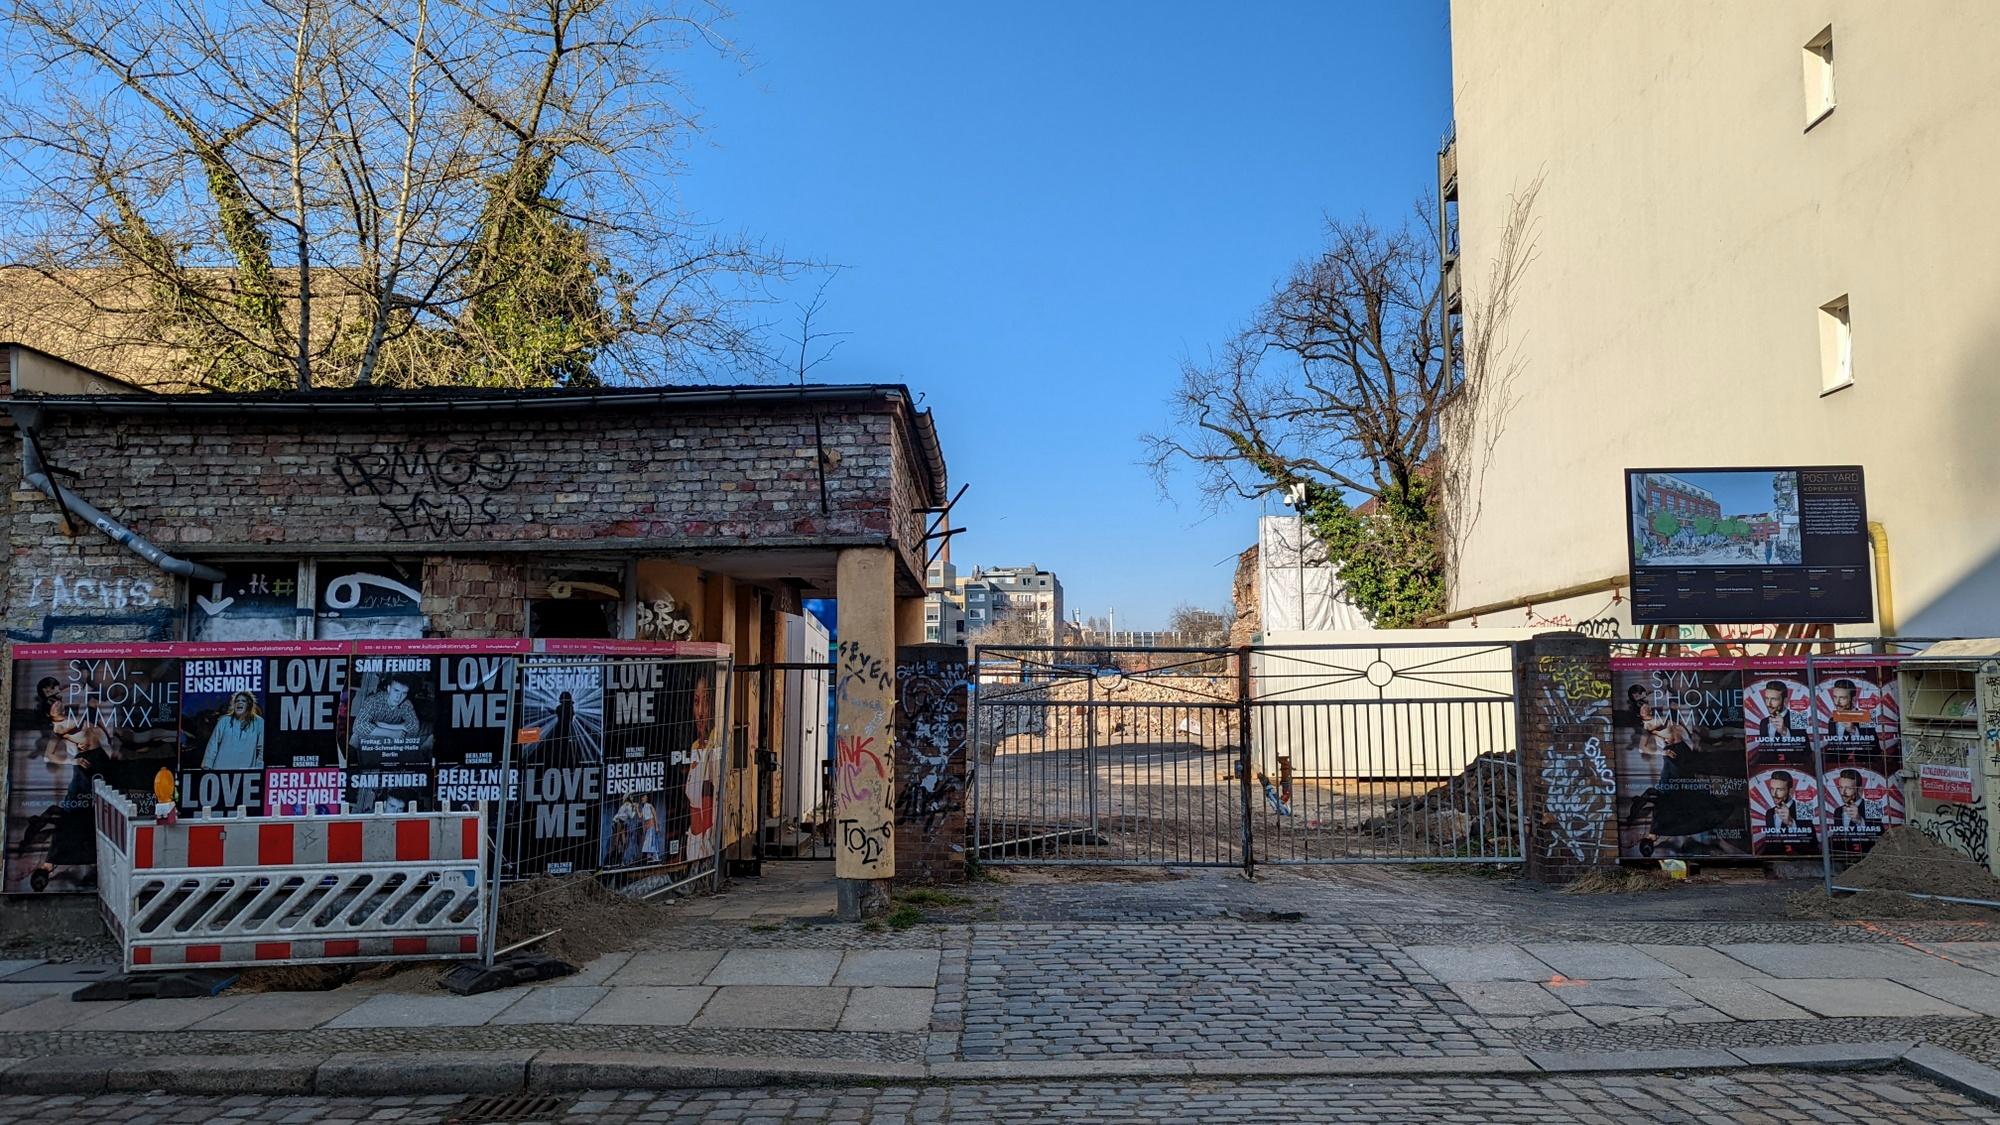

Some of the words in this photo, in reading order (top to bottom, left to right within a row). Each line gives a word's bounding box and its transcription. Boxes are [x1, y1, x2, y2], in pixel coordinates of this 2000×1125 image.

[1802, 473, 1828, 483] POST
[1832, 472, 1859, 481] YARD
[68, 660, 144, 681] SYM-
[185, 659, 263, 677] BERLINER
[355, 659, 383, 673] SAM
[385, 658, 432, 672] FENDER
[440, 656, 521, 691] LOVE
[606, 658, 665, 690] LOVE
[185, 676, 262, 693] ENSEMBLE
[268, 658, 348, 693] LOVE
[528, 673, 600, 690] ENSEMBLE
[1651, 671, 1713, 689] SYM-
[69, 682, 179, 704] PHONIE
[1654, 689, 1743, 708] PHONIE
[66, 705, 153, 728] MMXX
[280, 695, 335, 731] ME
[452, 693, 513, 729] ME
[615, 691, 656, 725] ME
[1654, 708, 1725, 727] MMXX
[606, 762, 664, 778] BERLINER
[269, 773, 347, 789] BERLINER
[350, 774, 378, 789] SAM
[381, 773, 428, 788] FENDER
[526, 767, 600, 802] LOVE
[606, 776, 664, 795] ENSEMBLE
[1654, 783, 1680, 791] GEORG
[1681, 783, 1714, 791] FRIEDRICH
[1719, 783, 1743, 791] WALTZ
[1724, 777, 1748, 785] SASHA
[182, 773, 262, 808] LOVE
[268, 788, 346, 805] ENSEMBLE
[1709, 789, 1730, 797] HAAS
[60, 801, 90, 809] GEORG
[535, 803, 587, 839] ME
[1787, 826, 1813, 834] STARS
